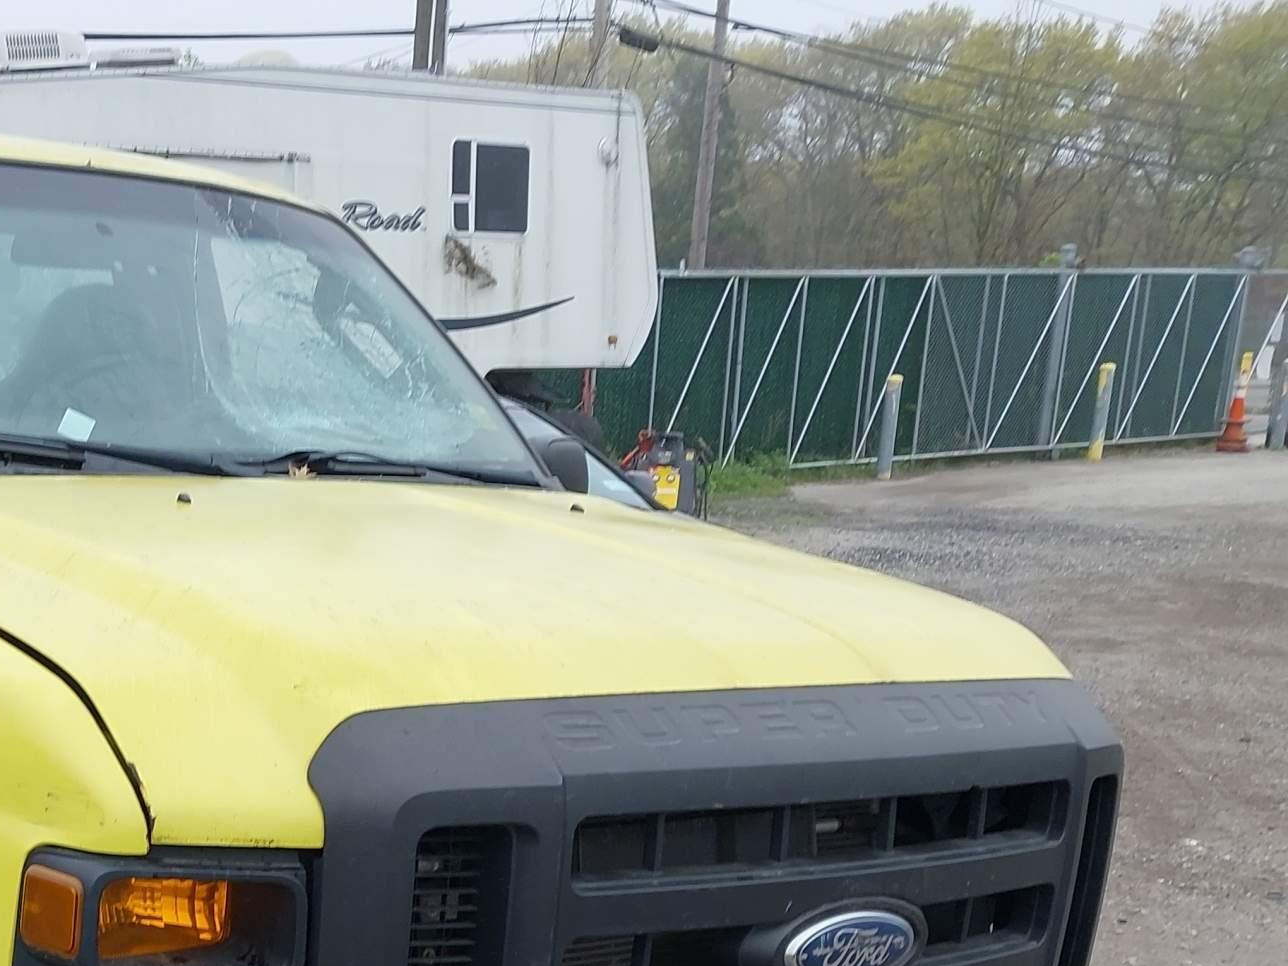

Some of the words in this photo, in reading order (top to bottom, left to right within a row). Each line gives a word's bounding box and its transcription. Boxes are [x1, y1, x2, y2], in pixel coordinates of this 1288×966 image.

[342, 201, 426, 232] Road
[543, 699, 857, 751] SUPER
[880, 689, 1048, 734] DUTY
